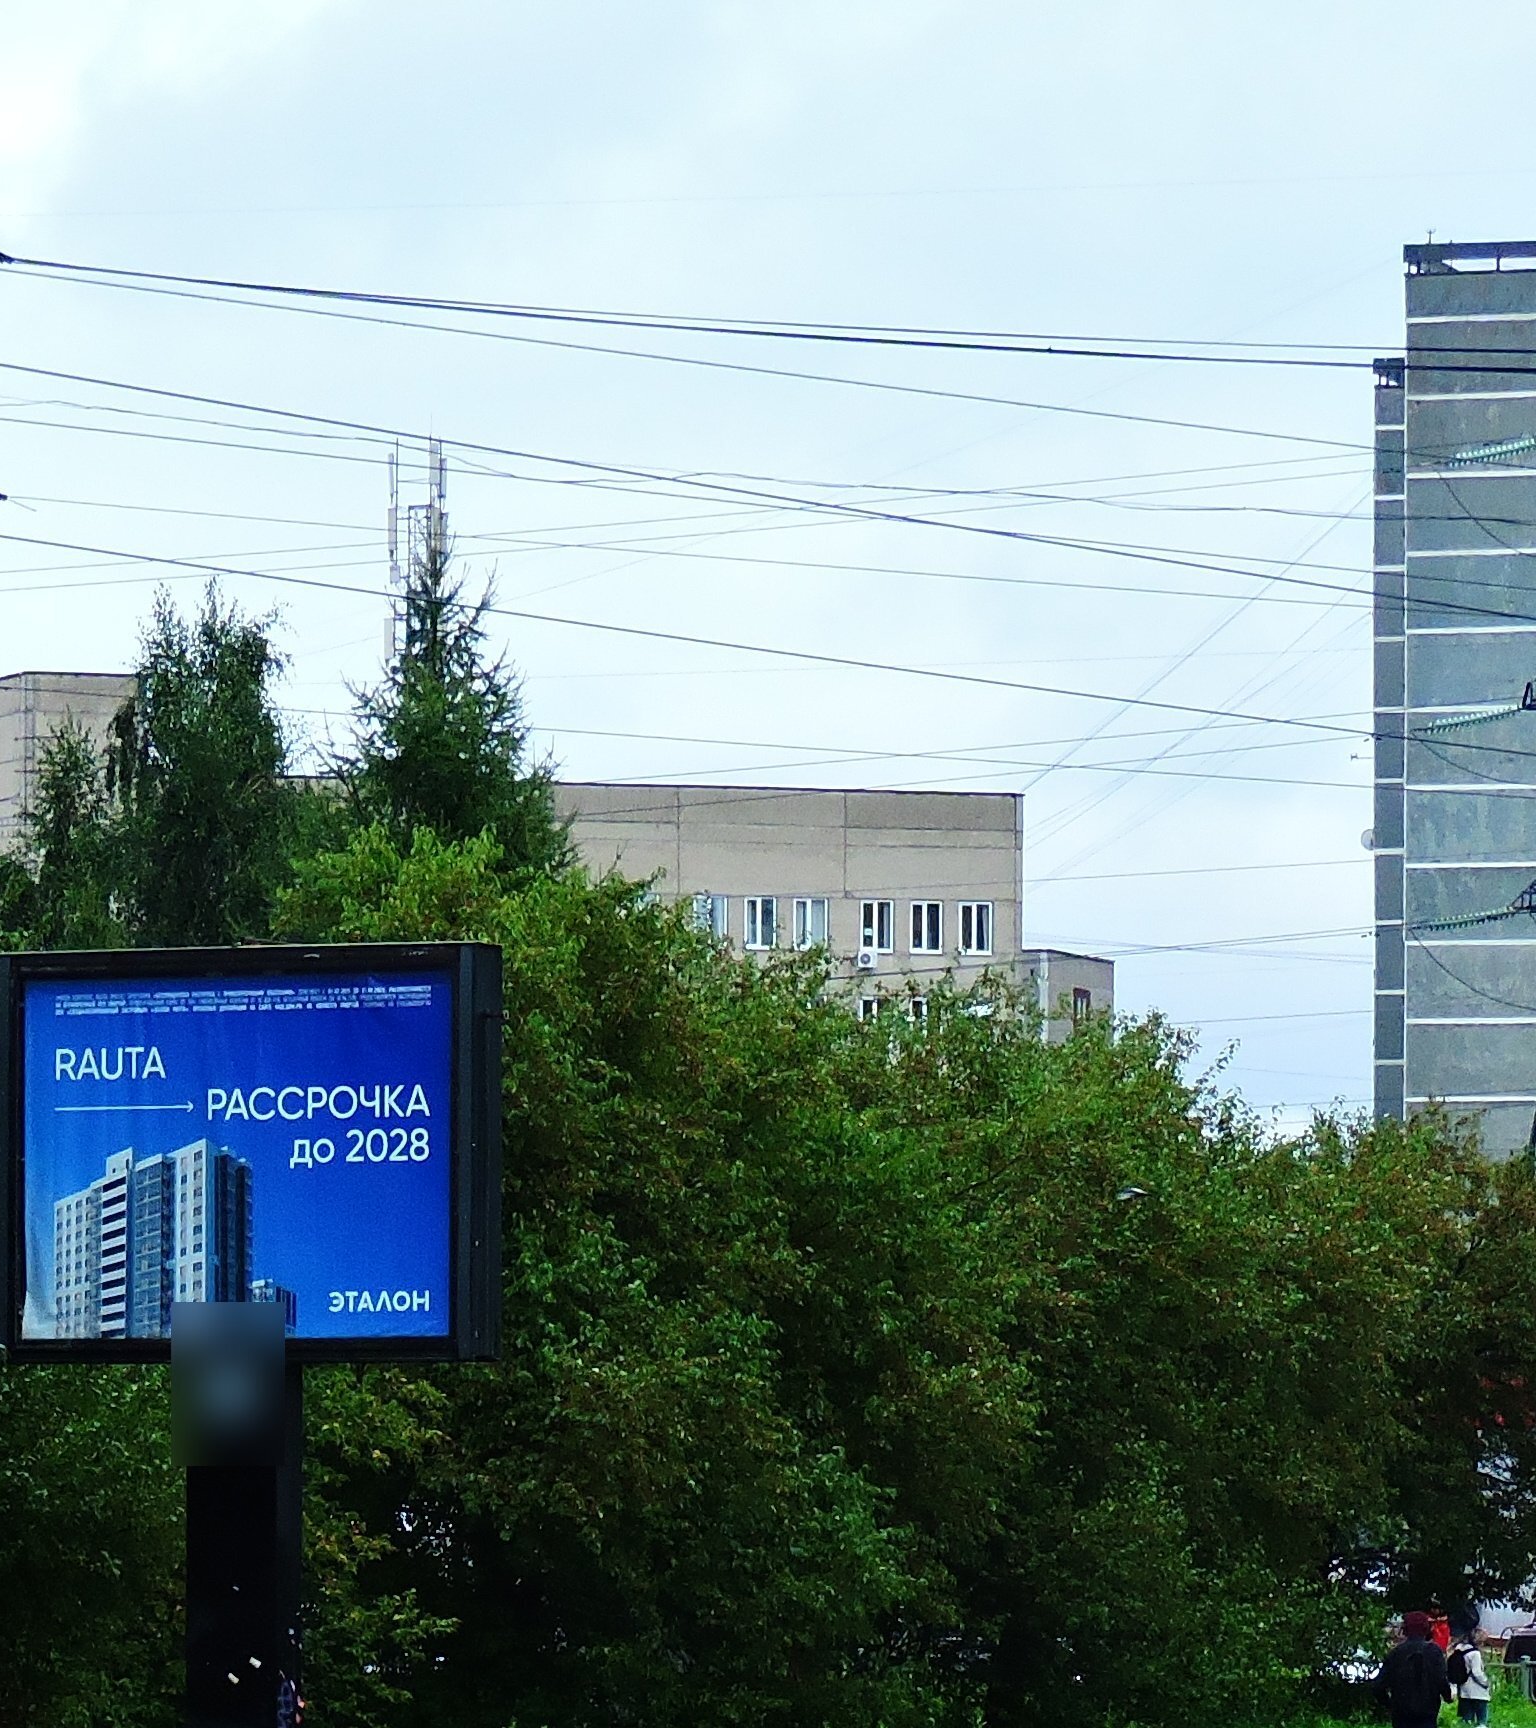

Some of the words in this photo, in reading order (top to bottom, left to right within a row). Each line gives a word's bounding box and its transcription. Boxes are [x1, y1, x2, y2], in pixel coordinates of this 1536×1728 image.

[55, 1047, 166, 1081] RAUTA
[207, 1084, 431, 1121] РАССРОЧКА
[289, 1138, 335, 1169] до
[346, 1128, 430, 1163] 2028
[328, 1290, 430, 1313] ЭТАЛОН
